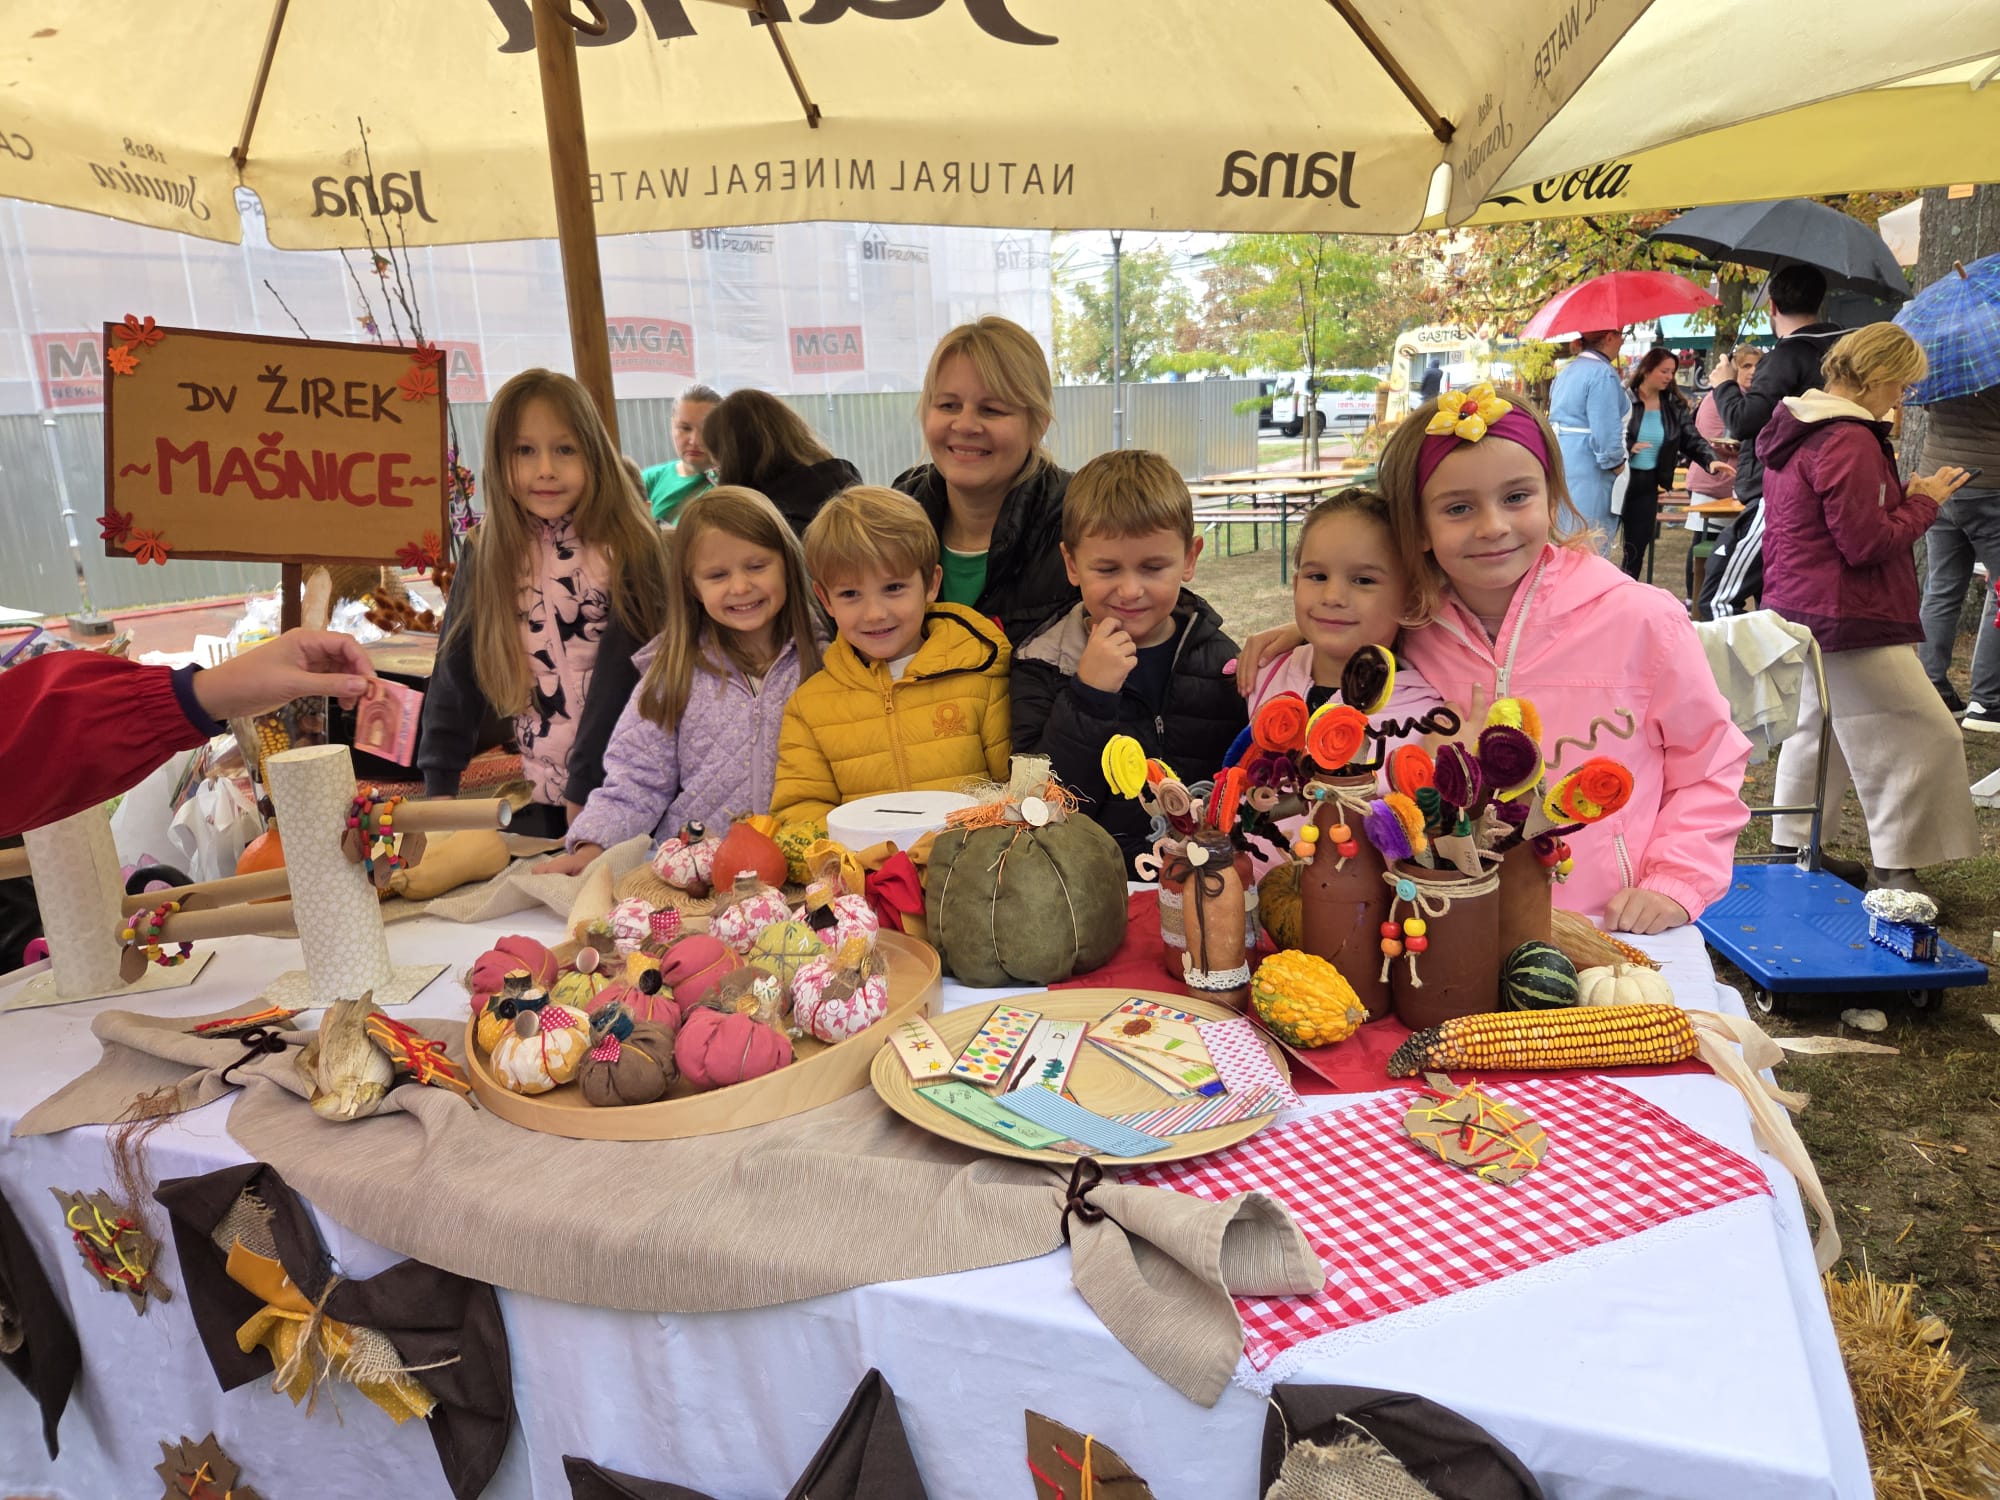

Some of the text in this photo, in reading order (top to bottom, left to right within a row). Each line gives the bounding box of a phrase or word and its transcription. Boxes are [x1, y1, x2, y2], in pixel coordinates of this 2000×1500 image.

[1532, 160, 1633, 204] Cola
[606, 324, 690, 357] MGA
[796, 332, 858, 357] MGA
[177, 382, 237, 414] DV
[257, 364, 402, 424] ŽIREK
